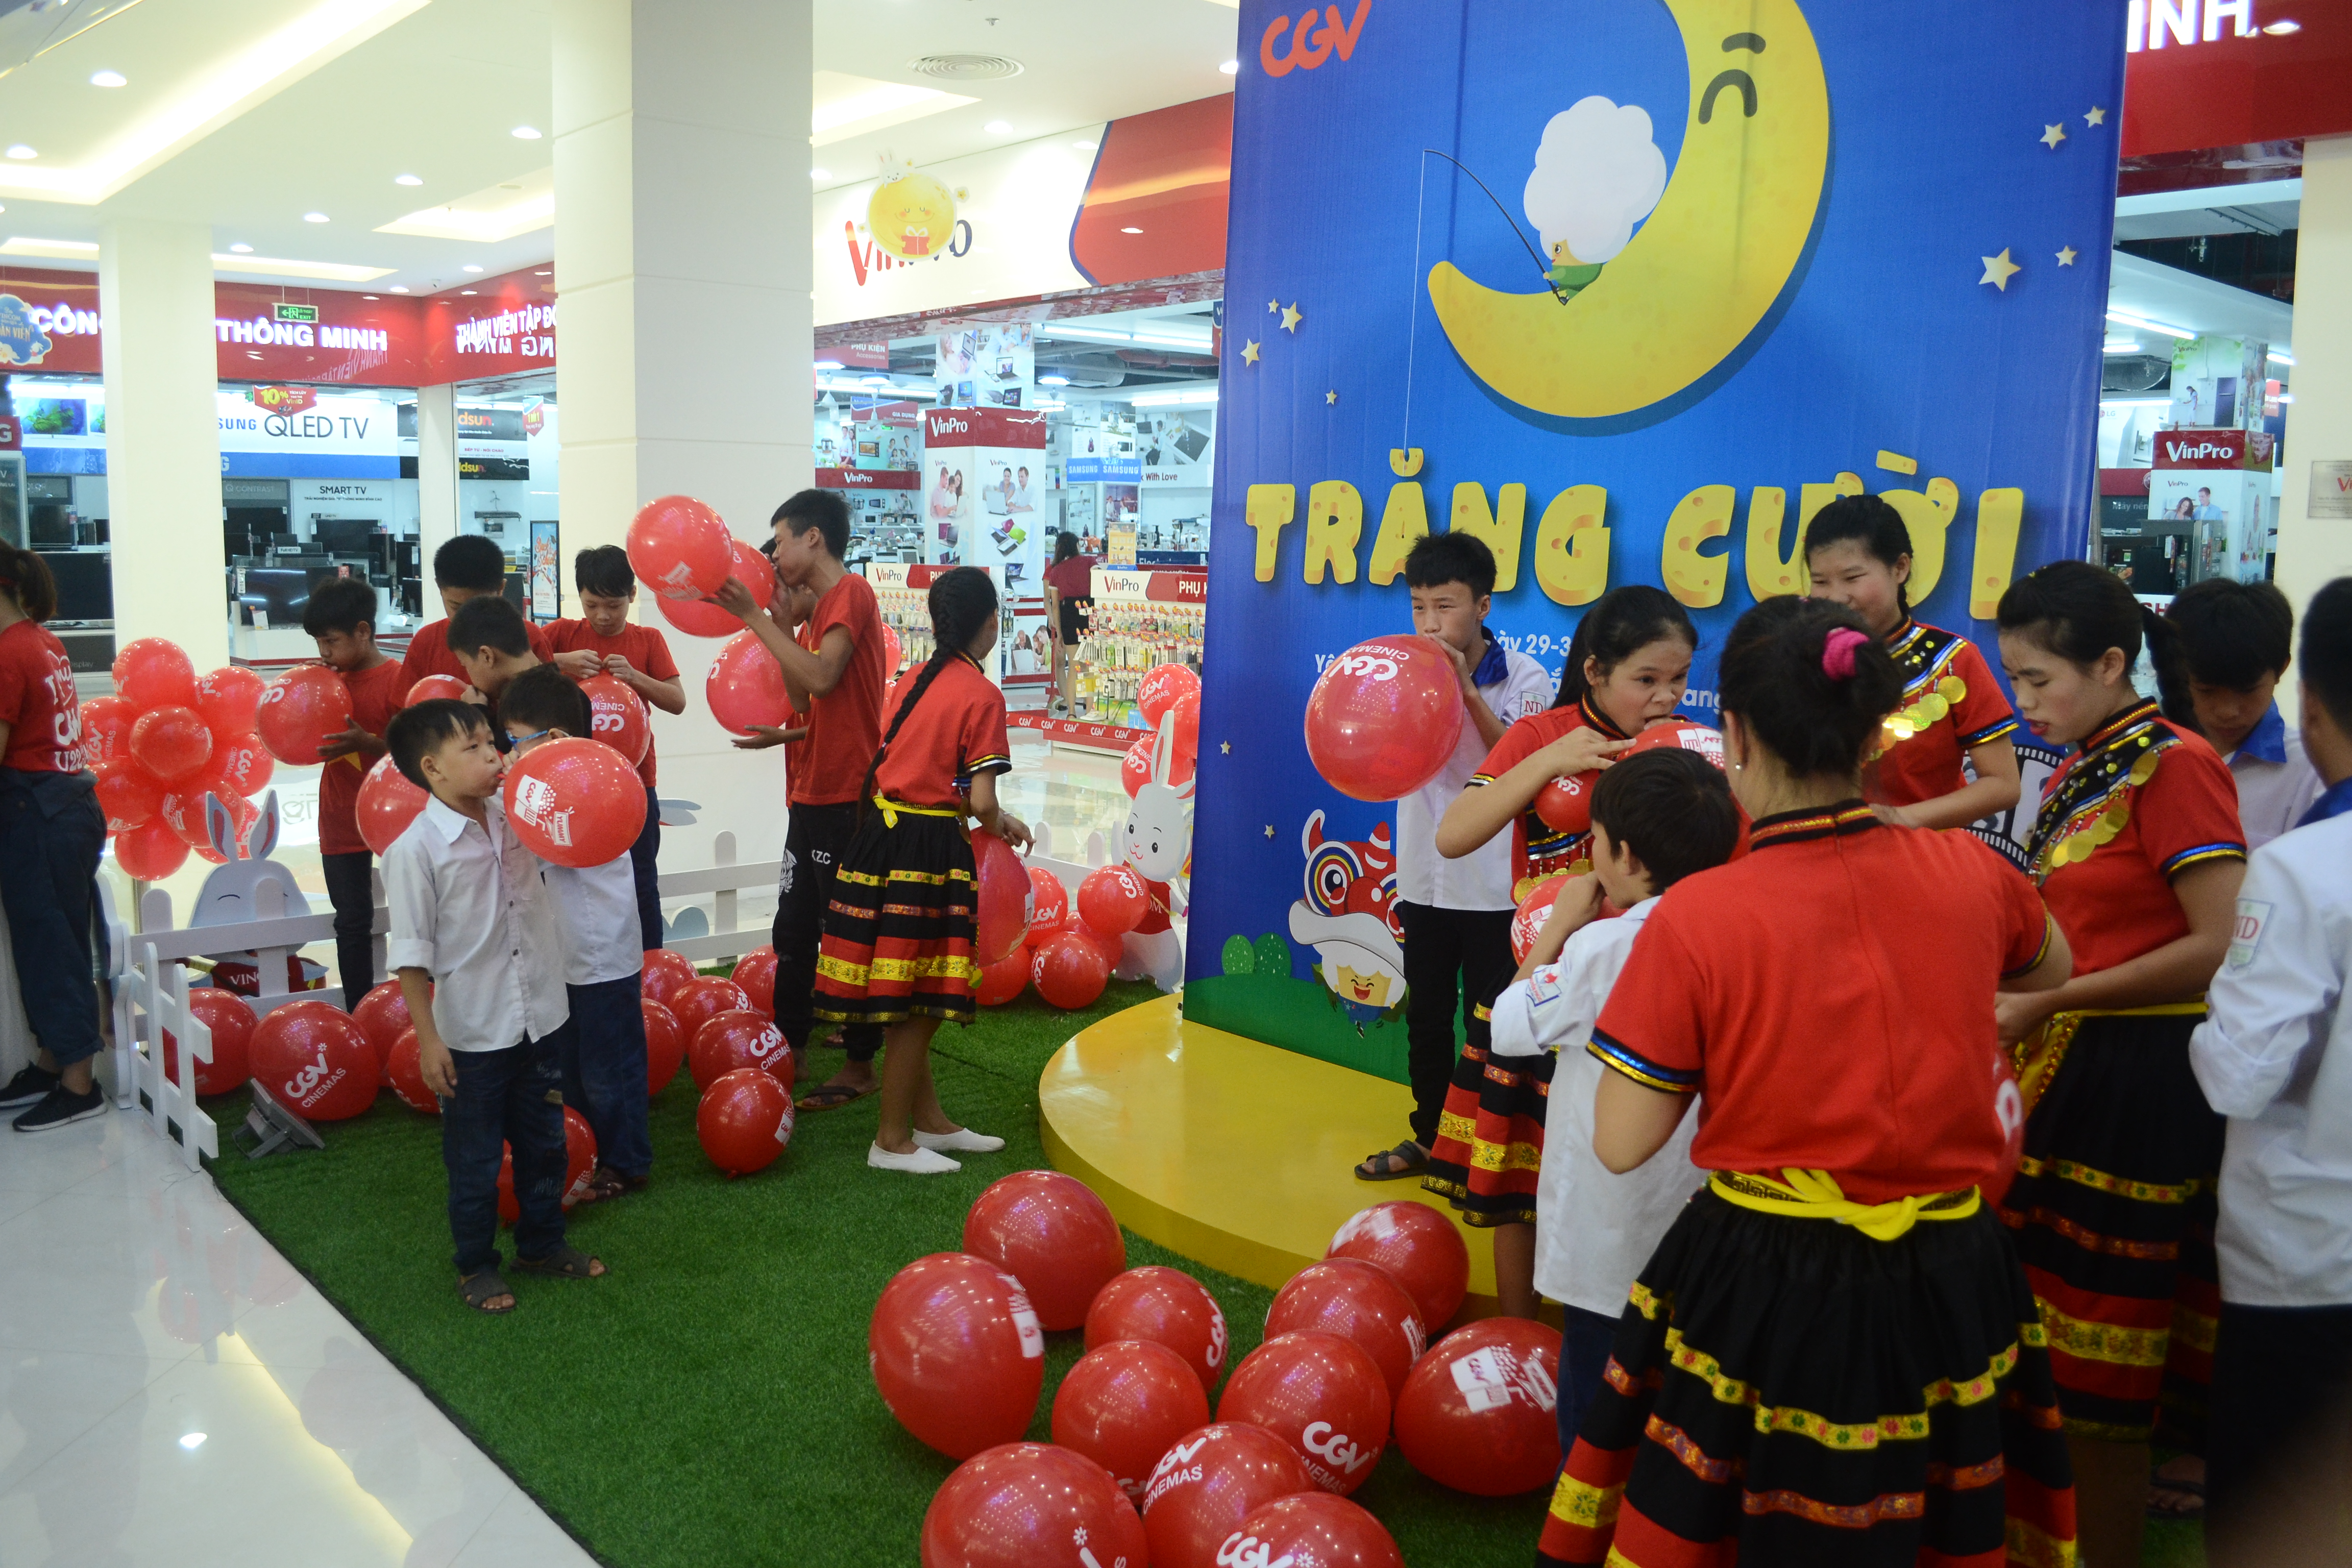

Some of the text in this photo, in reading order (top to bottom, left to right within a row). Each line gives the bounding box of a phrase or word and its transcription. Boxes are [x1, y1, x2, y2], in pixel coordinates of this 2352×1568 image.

[1260, 0, 1372, 78] CGV
[32, 305, 102, 334] CÔN
[493, 309, 518, 337] VIÊN
[518, 304, 542, 335] TẬP
[215, 317, 387, 351] THÔNG MINH
[264, 414, 333, 438] QLED
[339, 417, 369, 439] TV
[930, 416, 968, 437] VinPro
[2166, 441, 2233, 462] VinPro
[844, 472, 873, 483] VinPro
[1069, 465, 1097, 474] SAMSUNG
[1103, 465, 1138, 474] SAMSUNG
[1146, 473, 1159, 481] With
[1161, 472, 1178, 481] Love
[320, 486, 352, 494] SMART
[1245, 448, 1611, 606] TRĂNG
[876, 568, 901, 582] VinPro
[1105, 576, 1139, 593] VinPro
[1179, 580, 1200, 597] PHỤ
[1328, 655, 1399, 681] CGV
[1141, 677, 1164, 700] CGV
[1144, 690, 1170, 709] CINEMAS
[1524, 700, 1544, 714] ND
[1019, 717, 1031, 726] CGV
[1041, 721, 1054, 730] CGV
[1064, 723, 1077, 732] CGV
[1090, 727, 1104, 737] CGV
[1115, 730, 1129, 739] CGV
[224, 747, 237, 778] CINEMAS
[235, 749, 253, 782] CGV
[1124, 751, 1146, 773] CGV
[526, 782, 536, 803] CGV
[556, 816, 566, 842] YUMMY
[1114, 871, 1137, 898] CGV
[1125, 868, 1143, 896] CINEMAS
[1028, 920, 1059, 931] CINEMAS
[750, 1025, 781, 1057] CGV
[761, 1044, 791, 1070] CINEMAS
[285, 1052, 328, 1097] CGV
[302, 1068, 346, 1108] CINEMAS
[1303, 1422, 1370, 1474] CGV
[1145, 1437, 1207, 1492] CGV
[1301, 1455, 1346, 1496] INEMAS
[1143, 1466, 1203, 1514] CINEMAS
[1217, 1532, 1295, 1568] CGV
